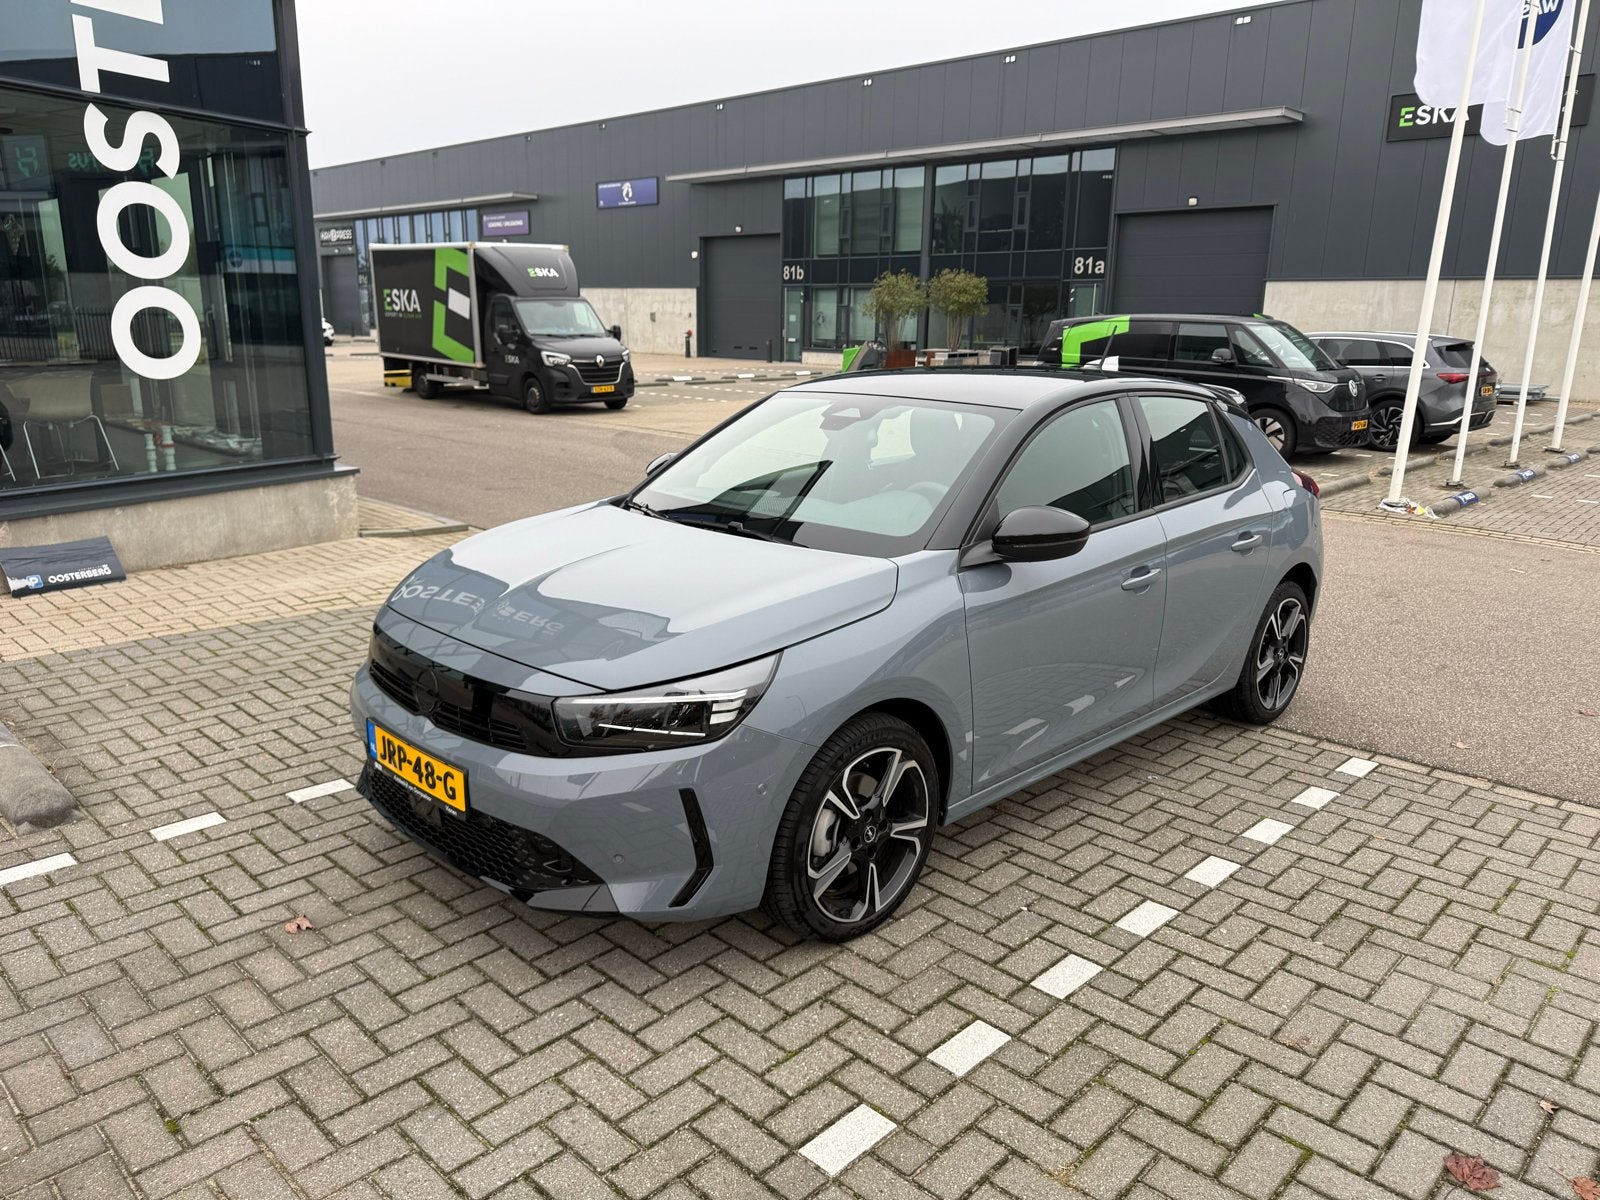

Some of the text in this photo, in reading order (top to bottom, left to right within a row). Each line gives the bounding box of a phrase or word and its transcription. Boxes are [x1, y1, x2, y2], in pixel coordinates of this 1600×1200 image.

[527, 267, 559, 278] ESKA
[783, 265, 804, 280] 81b
[1074, 256, 1105, 275] 81a
[383, 289, 421, 312] ESKA
[48, 567, 112, 584] OOSTERBERG
[379, 735, 457, 800] JRP-48-G
